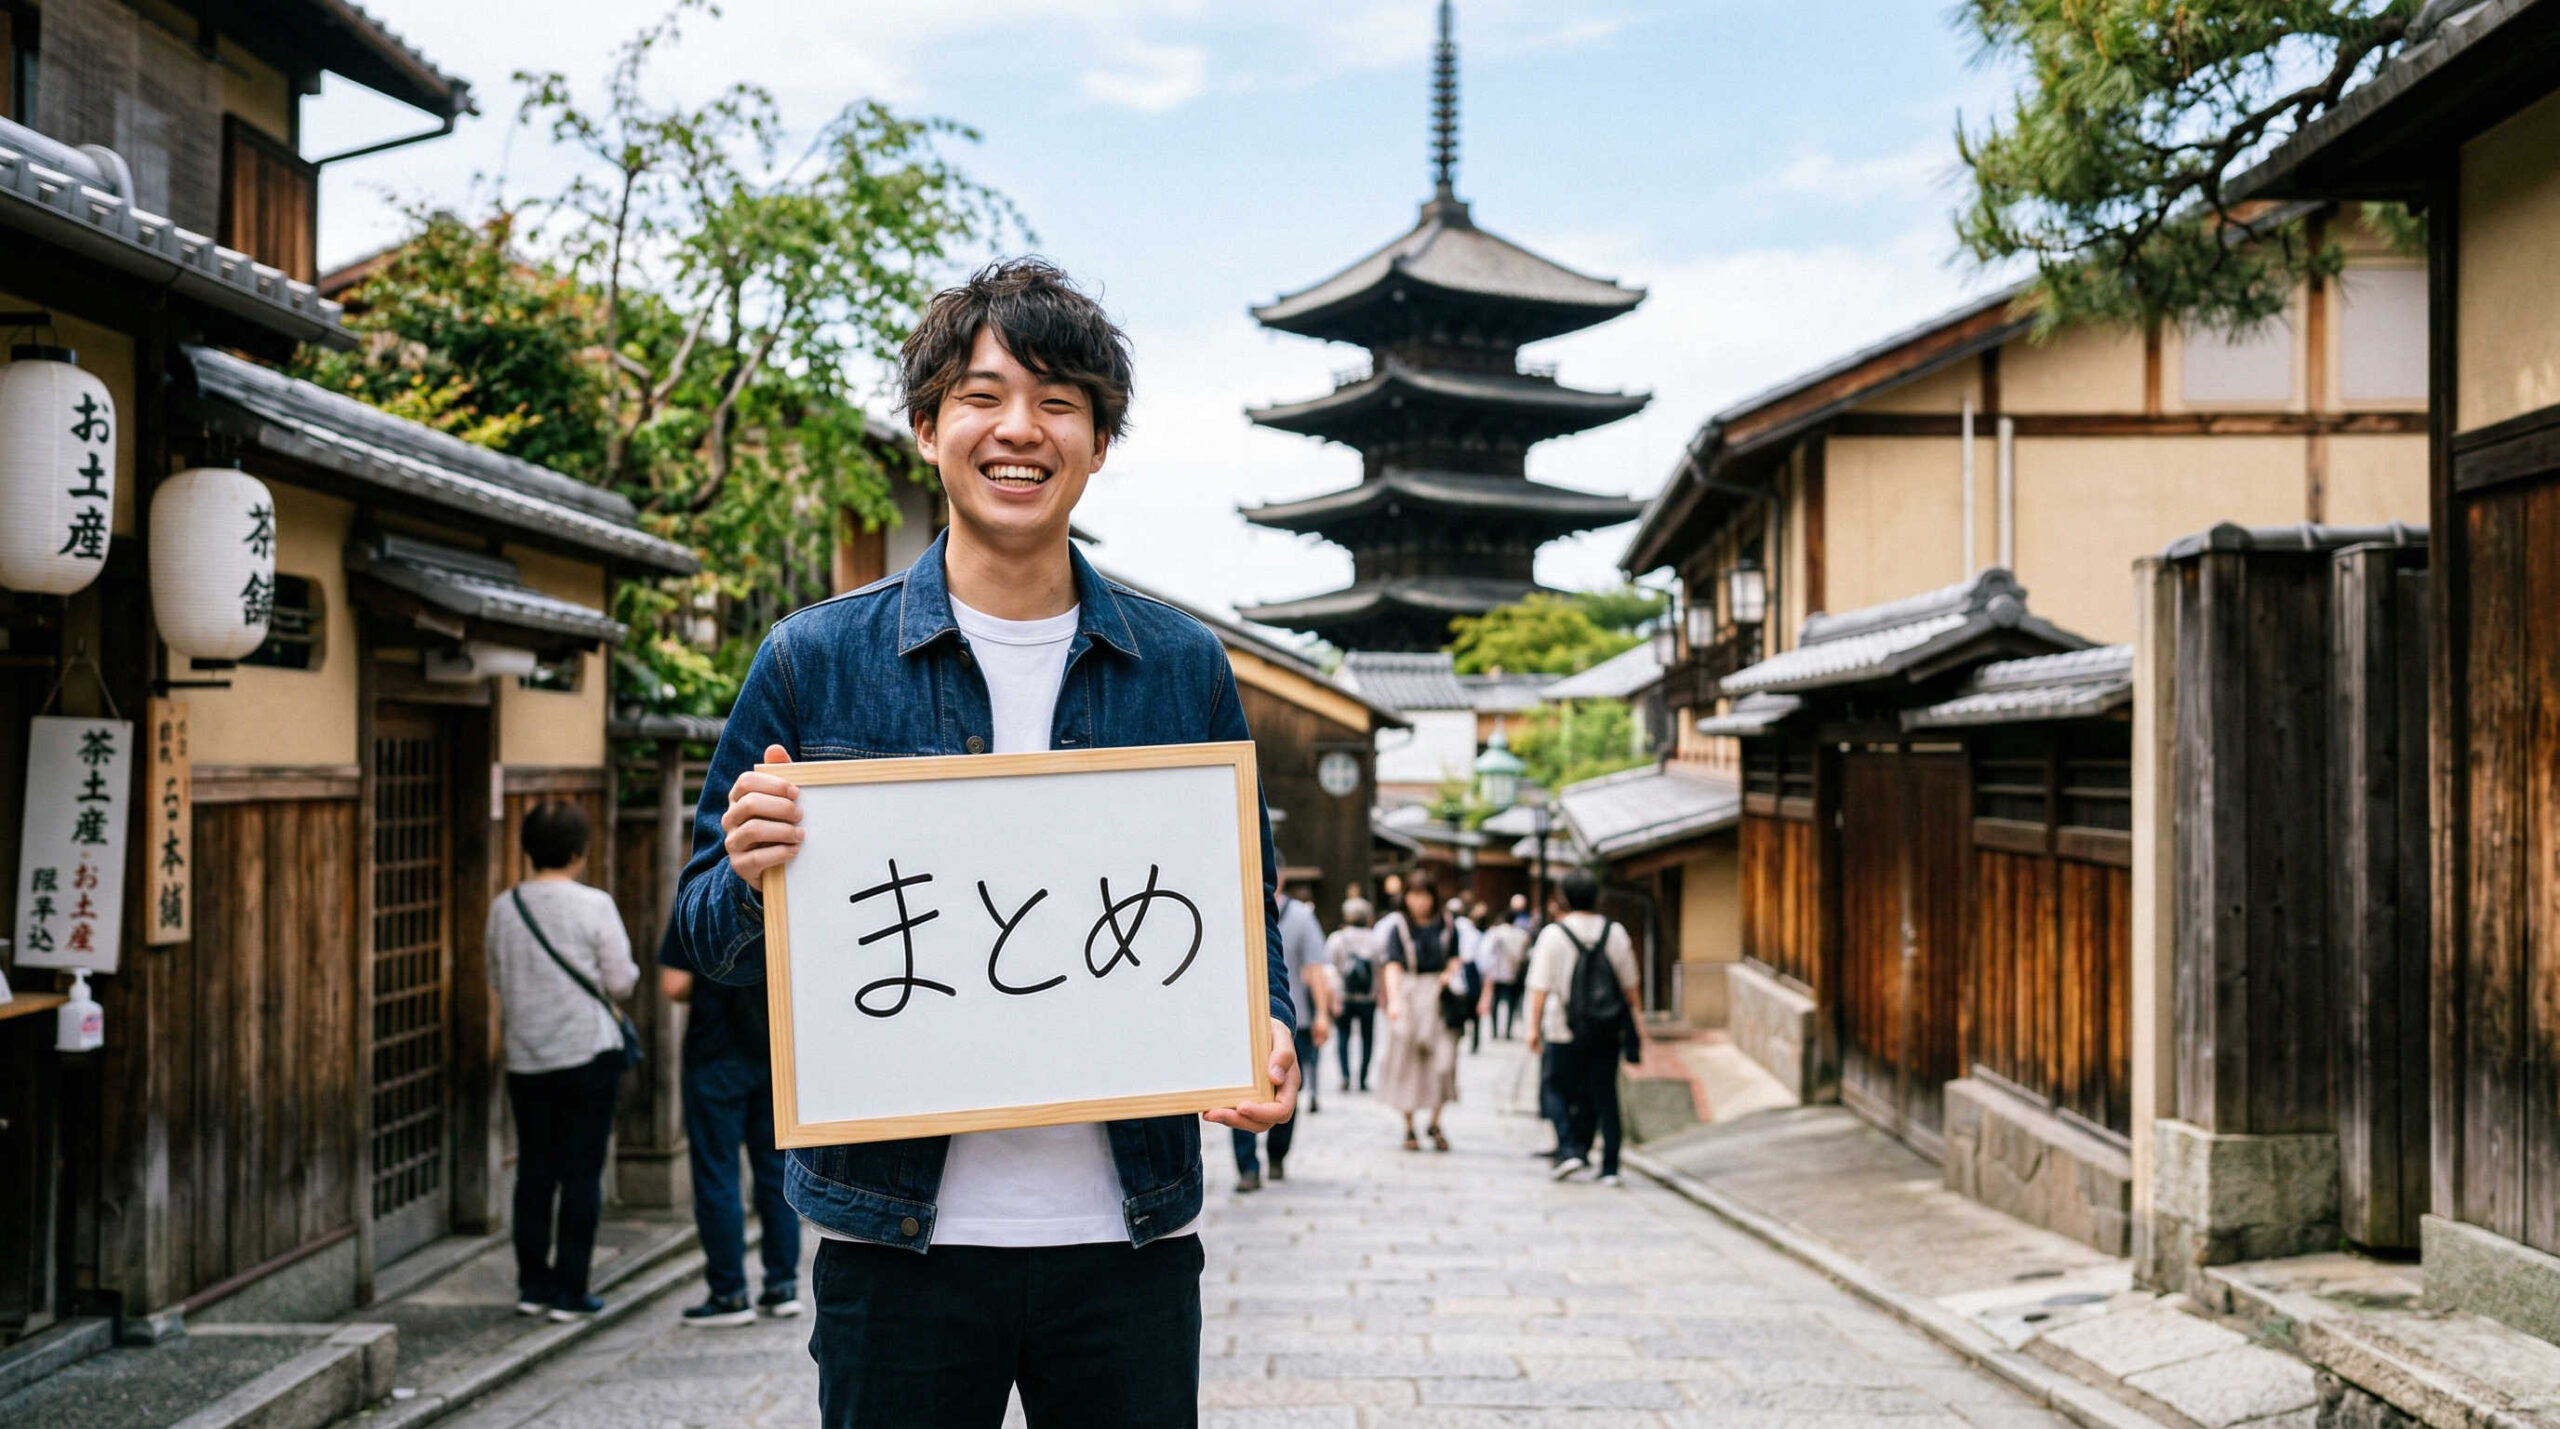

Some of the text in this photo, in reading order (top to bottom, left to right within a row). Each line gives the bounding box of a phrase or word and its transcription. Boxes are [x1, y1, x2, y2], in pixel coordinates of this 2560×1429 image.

[58, 392, 110, 560] お土産
[65, 728, 117, 953] 茶土産 お土産
[849, 857, 1203, 1018] まとめ
